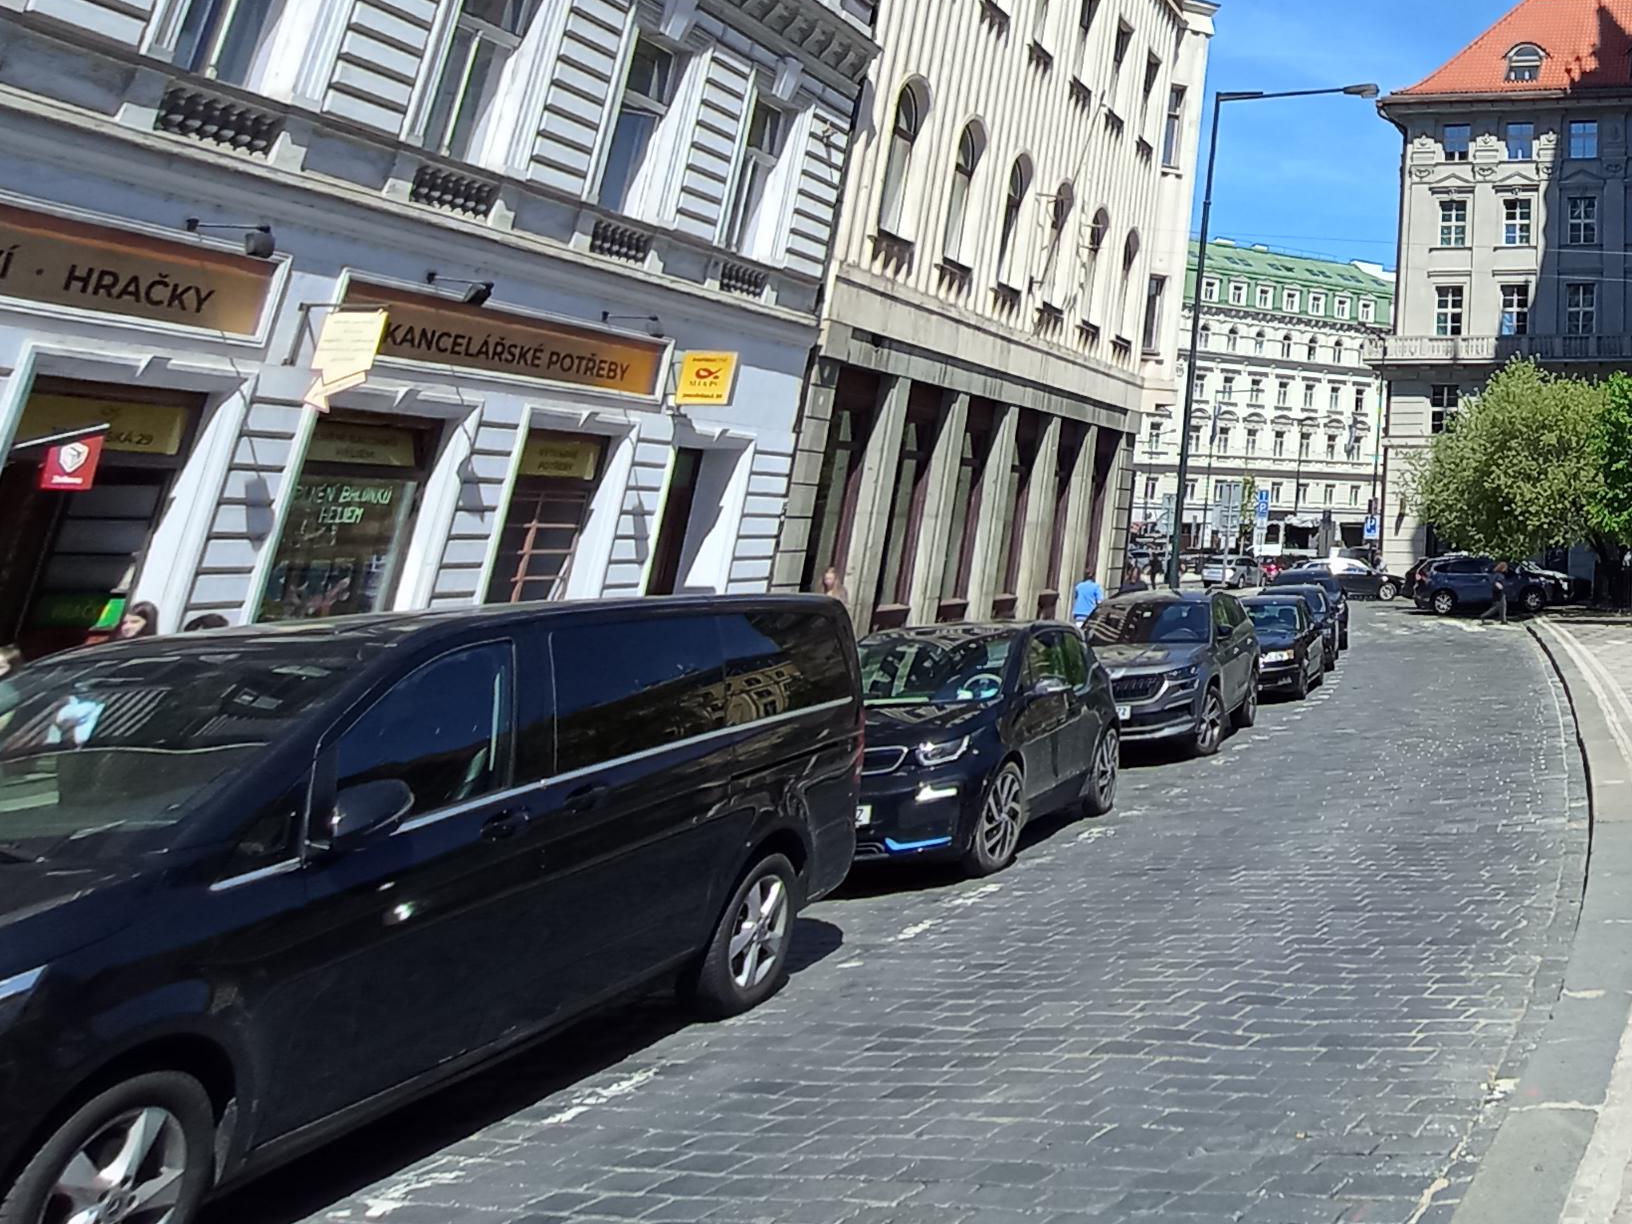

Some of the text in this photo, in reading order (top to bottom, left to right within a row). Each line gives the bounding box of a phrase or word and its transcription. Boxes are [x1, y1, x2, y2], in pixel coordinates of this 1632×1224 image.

[63, 263, 216, 314] HRAČKY
[384, 322, 545, 369] KANCELÁŘSKÉ
[546, 351, 633, 382] POTŘEBY
